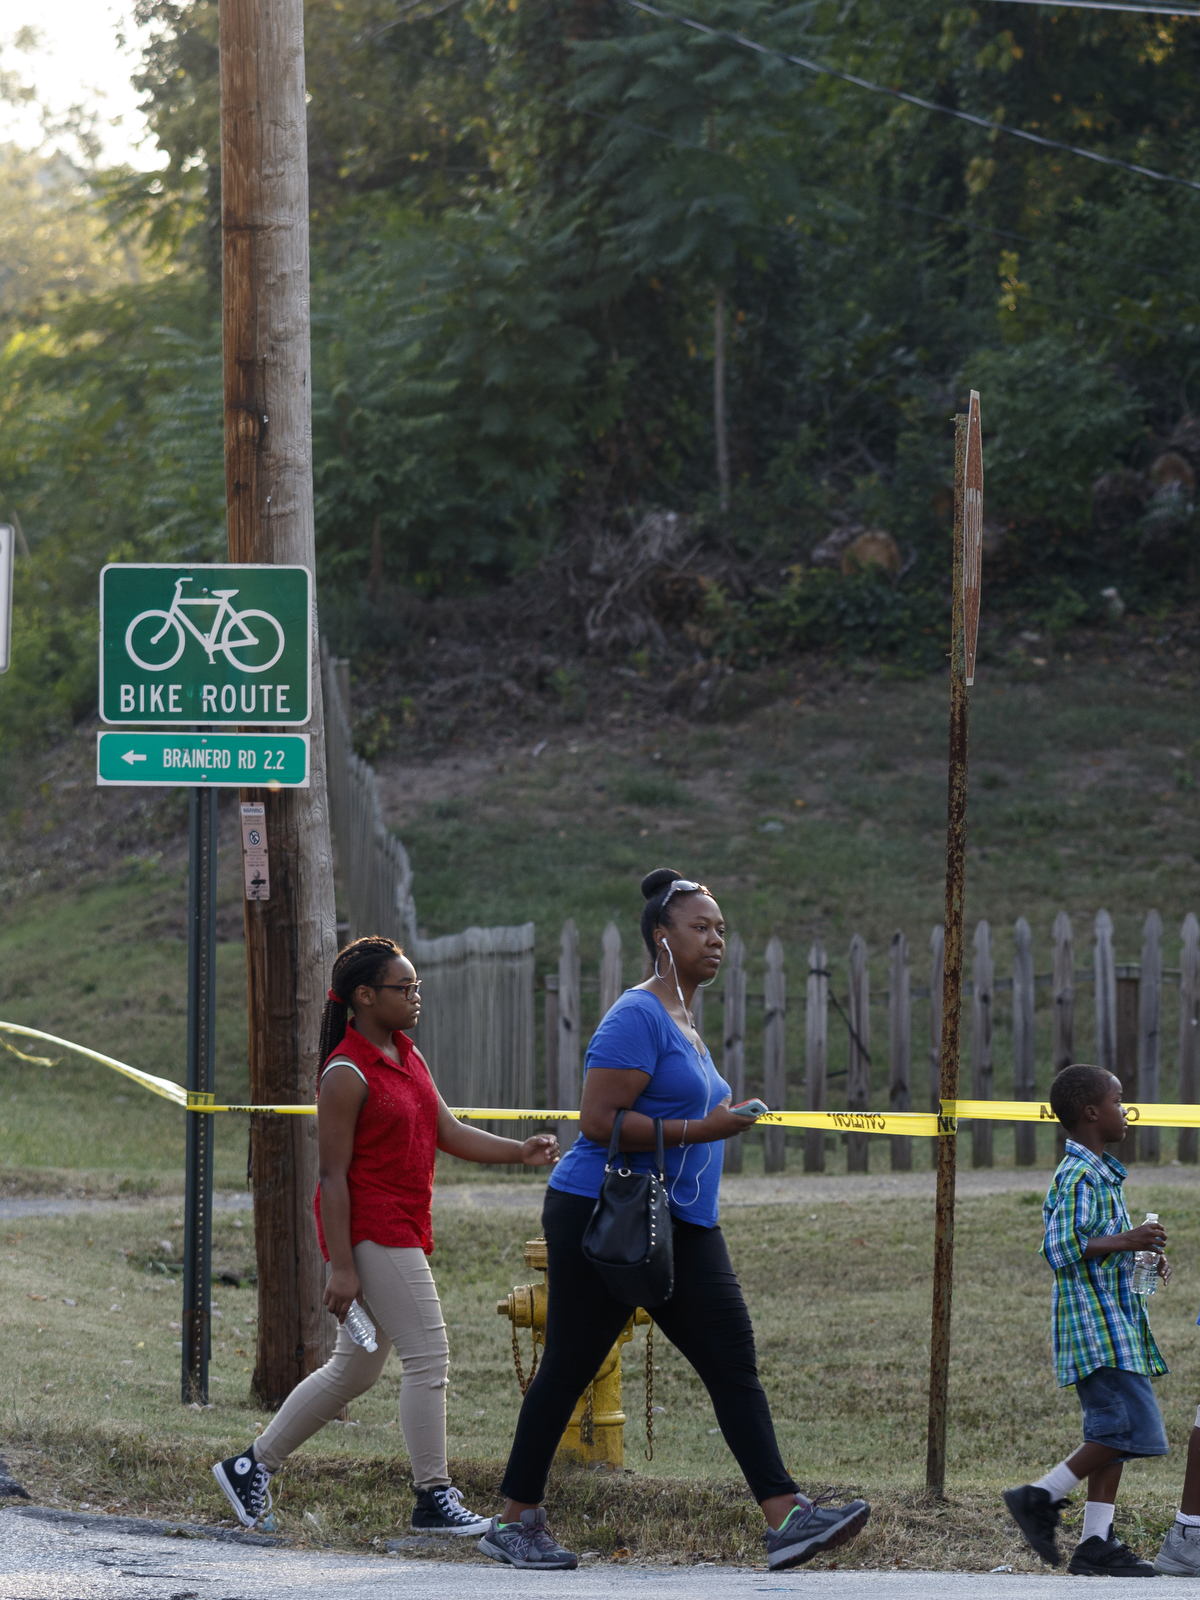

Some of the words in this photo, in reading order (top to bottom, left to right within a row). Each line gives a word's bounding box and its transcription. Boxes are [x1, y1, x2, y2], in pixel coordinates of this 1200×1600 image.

[120, 684, 183, 713] BIKE
[202, 684, 291, 713] ROUTE
[162, 748, 231, 769] BRAINERD
[238, 749, 256, 769] RD
[263, 750, 286, 770] 2.2
[827, 1112, 886, 1130] CAUTION
